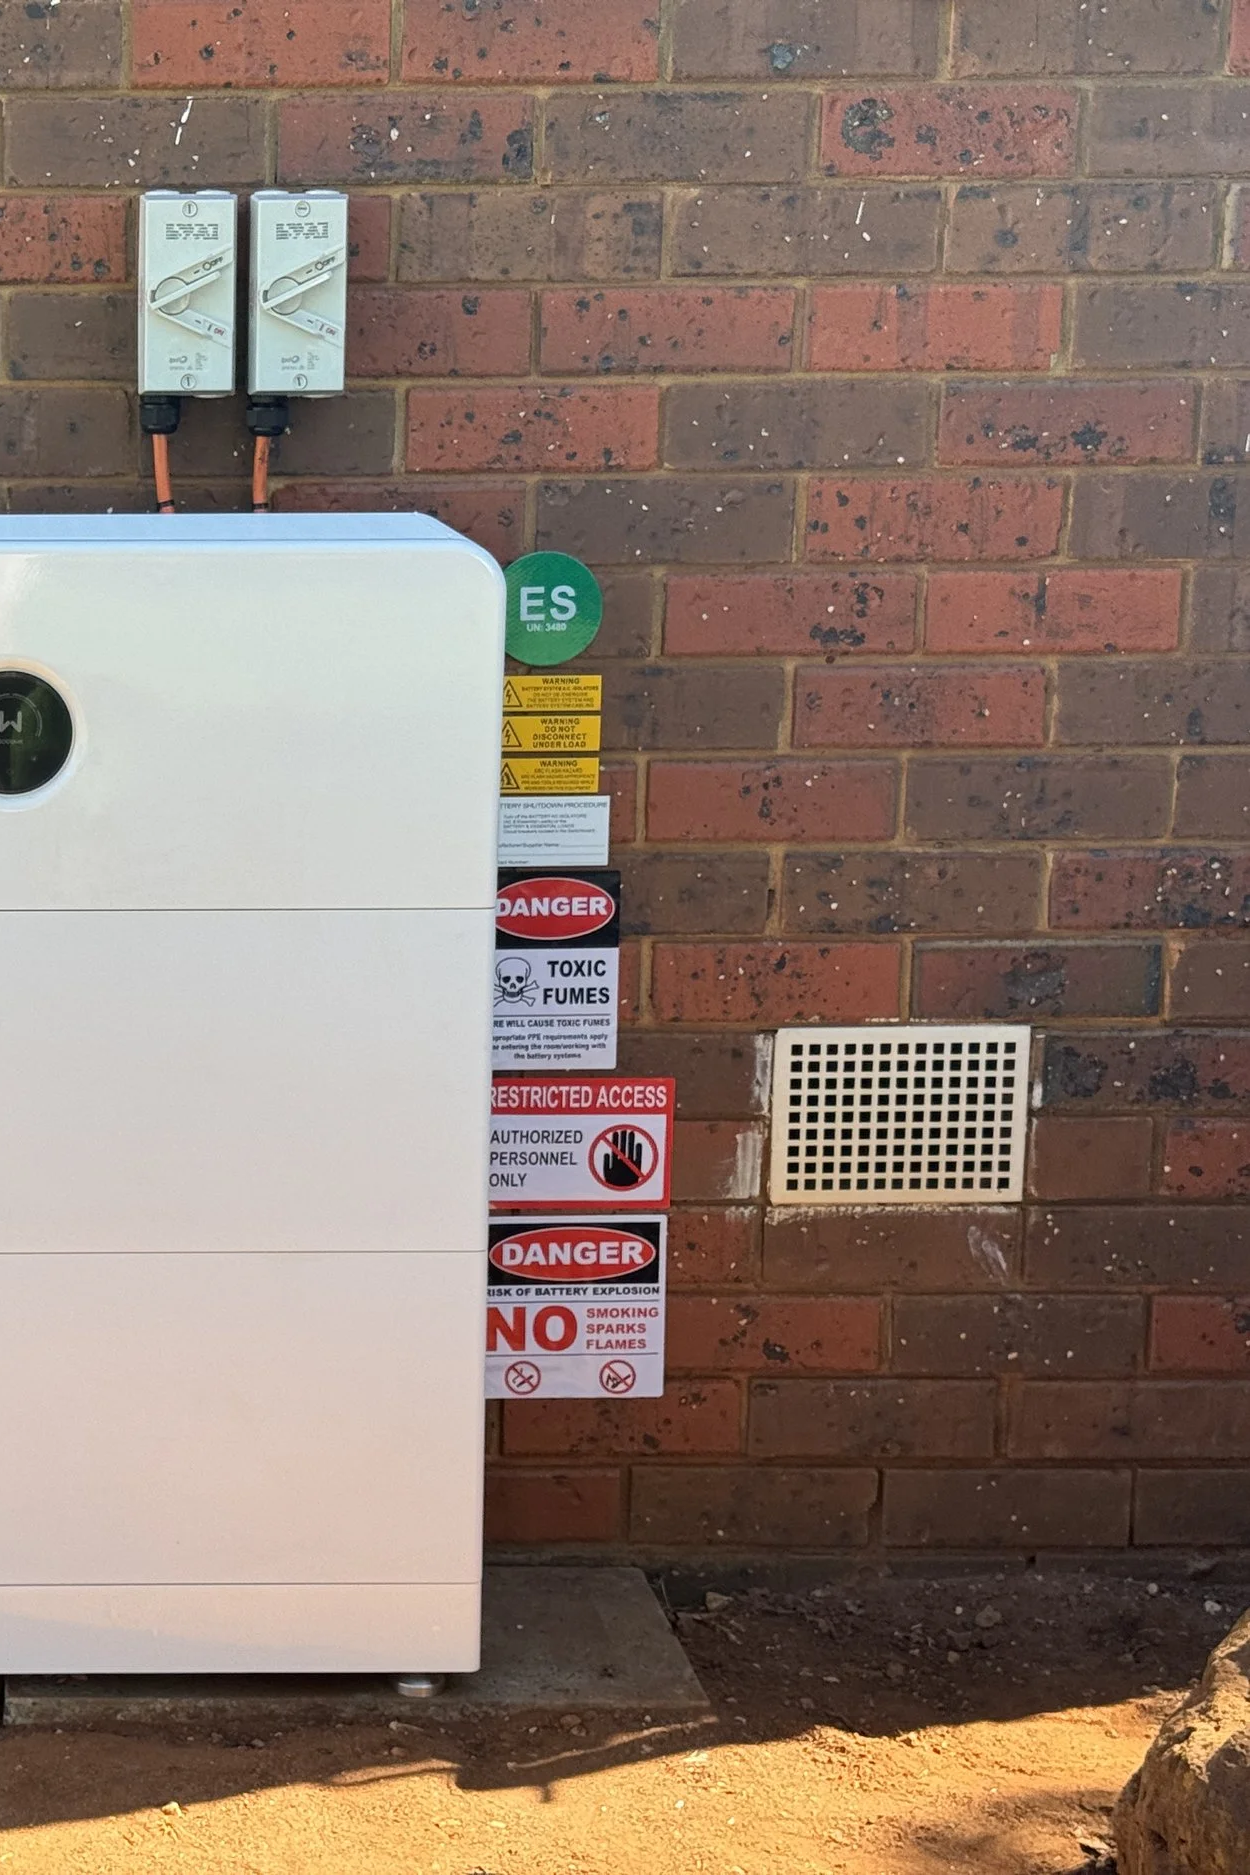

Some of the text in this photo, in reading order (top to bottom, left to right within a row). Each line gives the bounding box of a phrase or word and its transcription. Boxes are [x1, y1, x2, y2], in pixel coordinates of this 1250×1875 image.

[520, 585, 577, 621] ES
[542, 677, 580, 685] WARNING
[540, 717, 580, 725] WARNING
[532, 733, 587, 741] DISCONNECT
[496, 896, 607, 917] DANGER
[547, 960, 606, 978] TOXIC
[543, 987, 610, 1005] FUMES
[506, 1020, 526, 1028] WILL
[527, 1019, 554, 1028] CAUSE
[557, 1019, 581, 1027] TOXIC
[582, 1018, 610, 1027] FUMES
[542, 1033, 588, 1041] requirements
[589, 1032, 608, 1041] apply
[500, 1043, 529, 1052] entering
[543, 1042, 590, 1051] room/working
[513, 1052, 582, 1061] the battery systems
[491, 1085, 667, 1109] RESTRICTED ACCESS
[490, 1129, 583, 1144] AUTHORIZED
[489, 1151, 578, 1166] PERSONNEL
[488, 1172, 528, 1187] ONLY
[502, 1241, 644, 1267] DANGER
[515, 1287, 531, 1297] OF
[534, 1287, 589, 1297] BATTERY
[592, 1286, 660, 1296] EXPLOSION
[586, 1307, 659, 1319] SMOKING
[486, 1305, 578, 1353] NO
[586, 1323, 647, 1335] SPARKS
[585, 1338, 647, 1350] FLAMES
